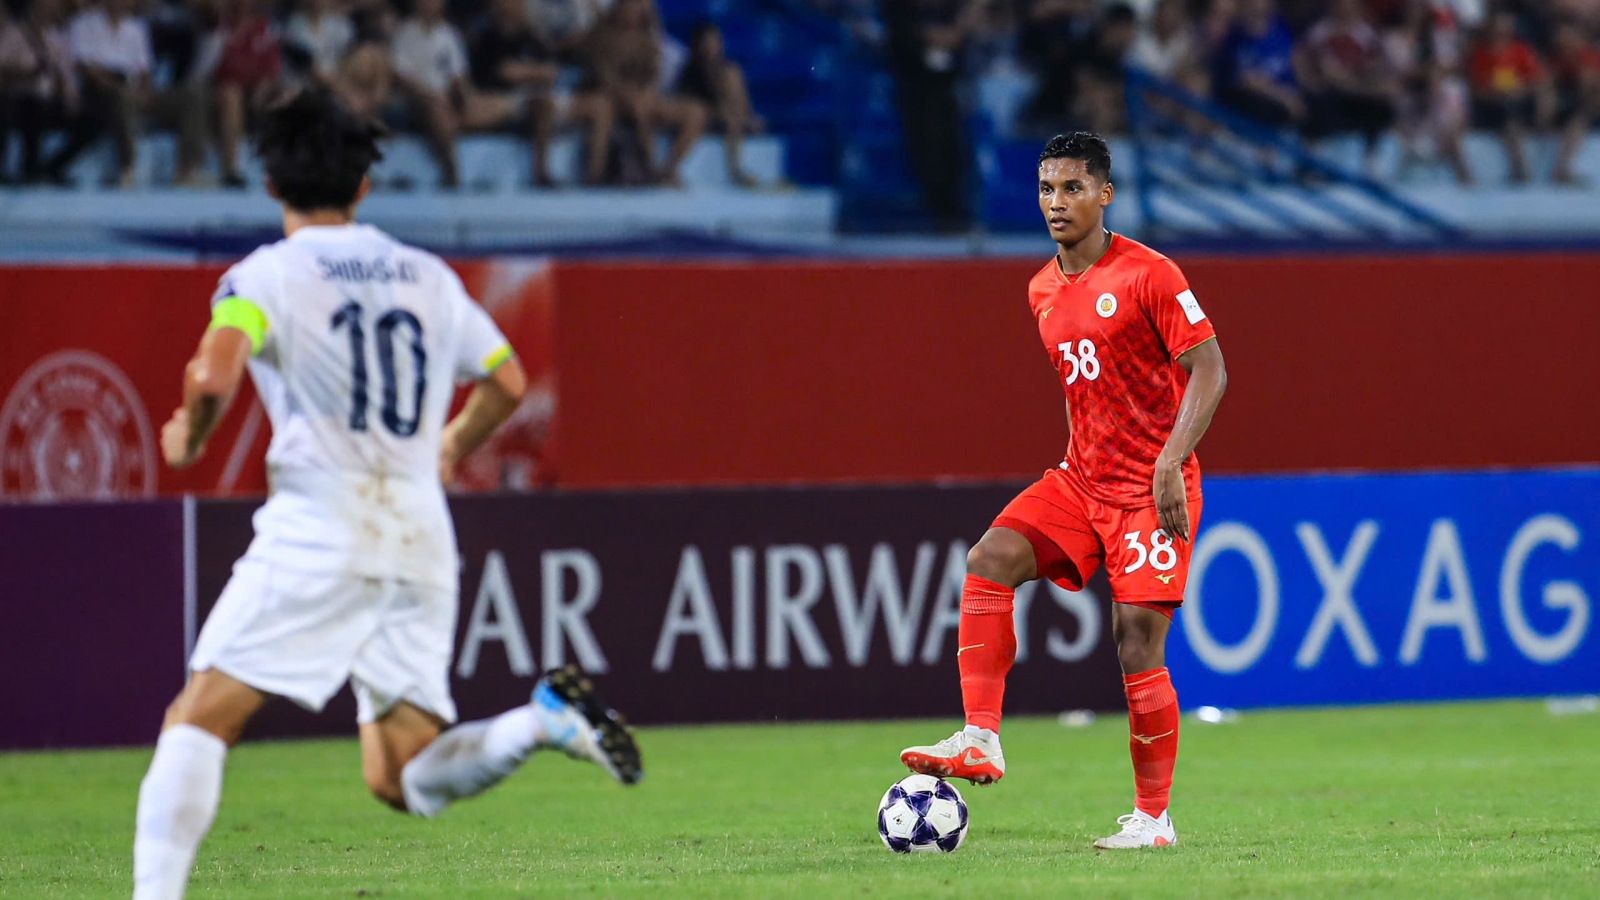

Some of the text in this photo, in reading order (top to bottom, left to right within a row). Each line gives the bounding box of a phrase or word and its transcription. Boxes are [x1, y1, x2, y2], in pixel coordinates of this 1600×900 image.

[330, 301, 427, 438] 10
[1058, 338, 1101, 386] 38
[455, 548, 609, 678] AR
[1124, 528, 1178, 575] 38
[1180, 512, 1591, 675] OXAG
